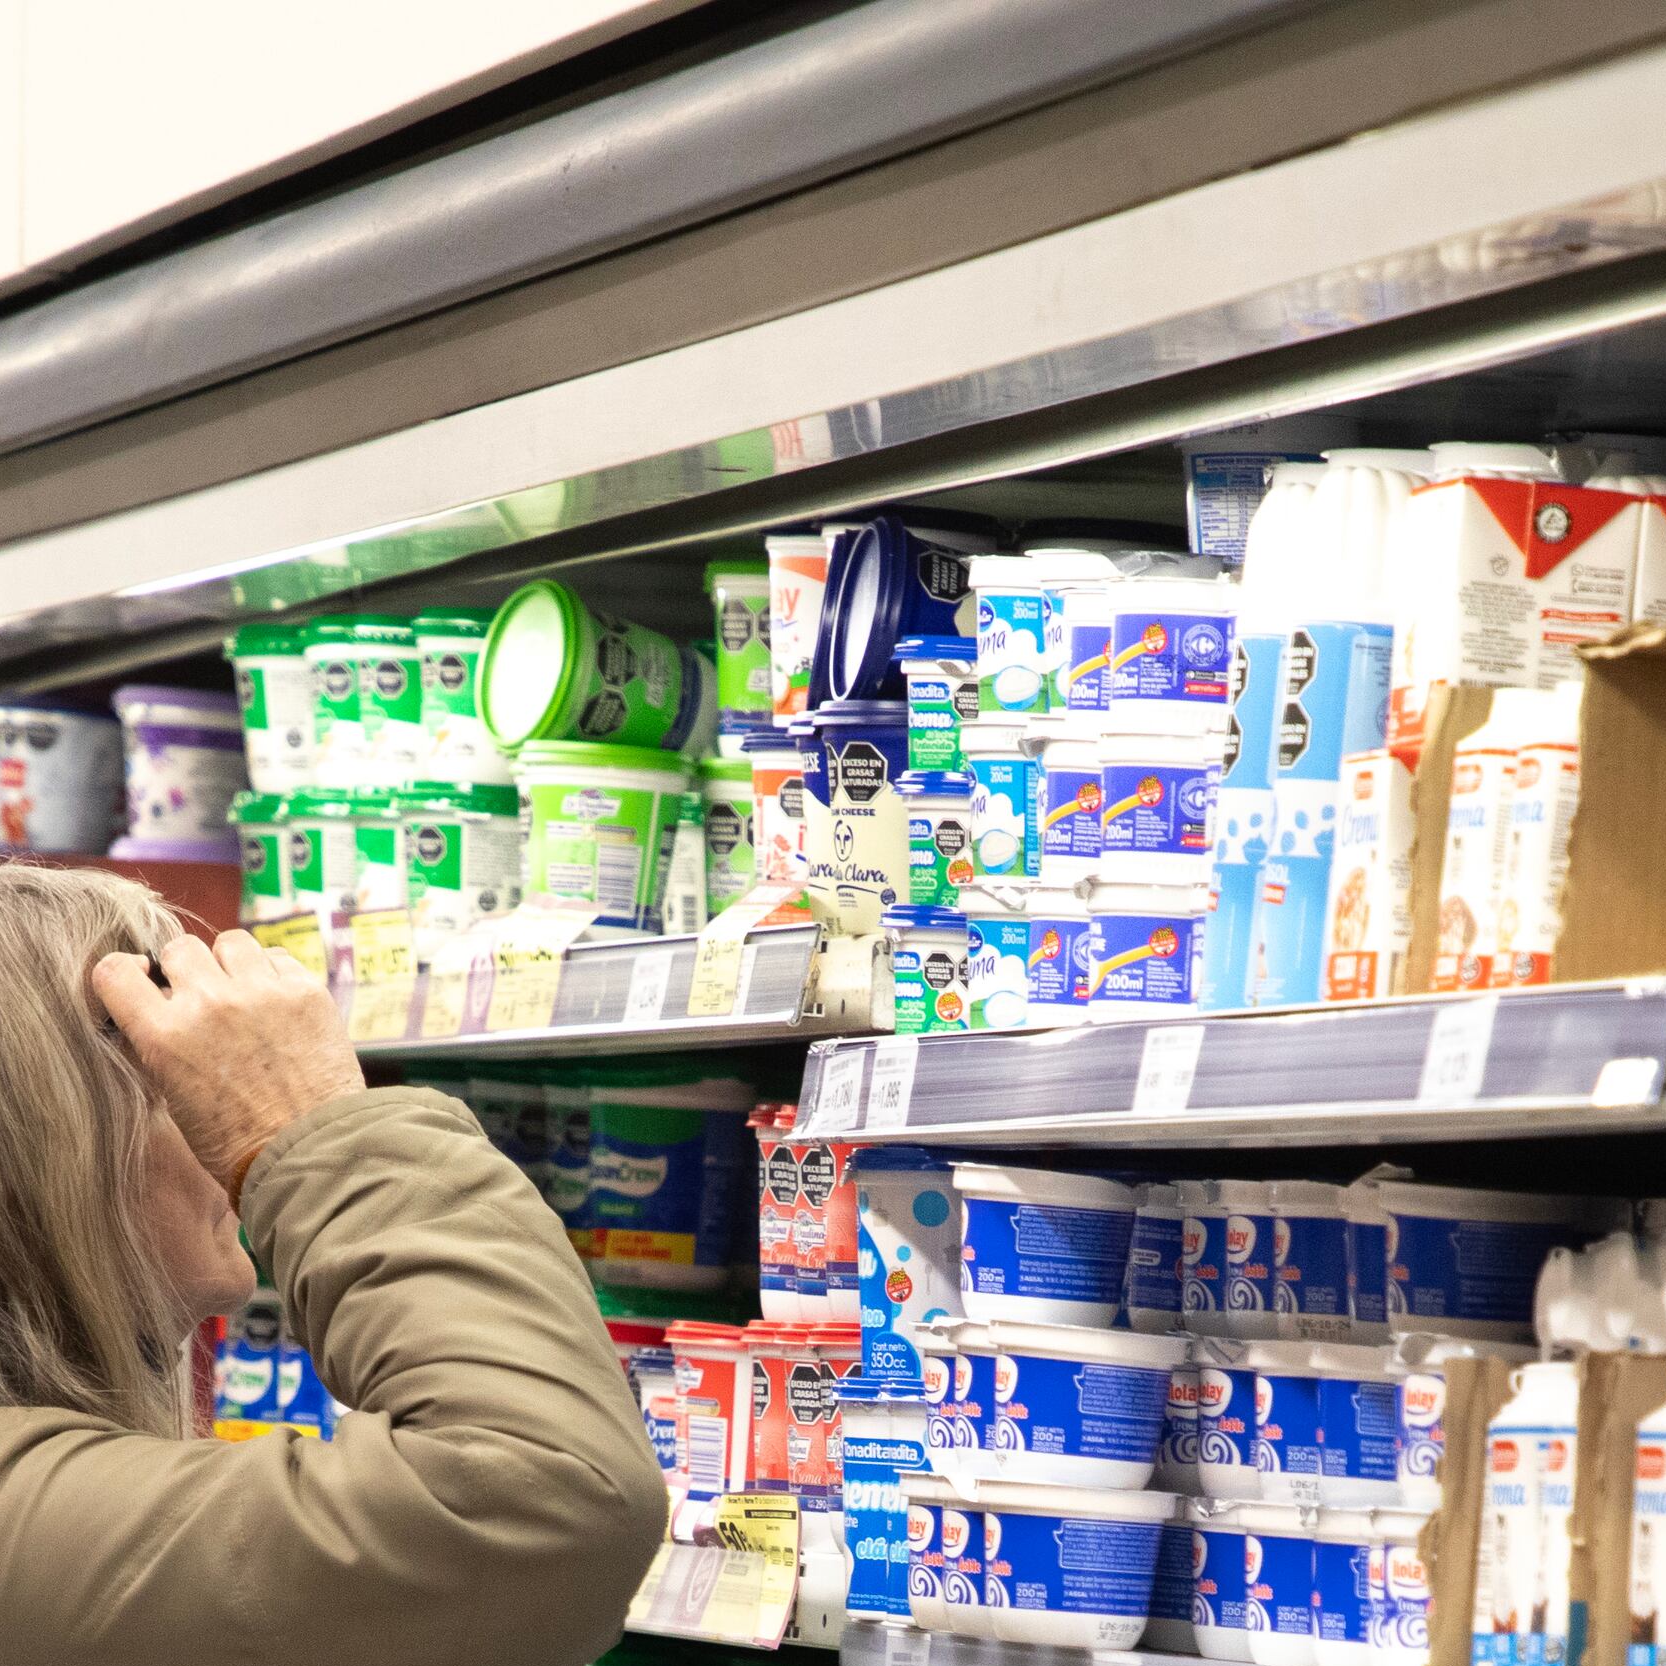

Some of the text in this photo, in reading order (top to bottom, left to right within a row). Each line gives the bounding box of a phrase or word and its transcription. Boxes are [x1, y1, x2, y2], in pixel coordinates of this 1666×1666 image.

[1105, 974, 1144, 991] 200ml
[870, 1352, 907, 1370] 350cc
[1033, 1432, 1053, 1443] 200
[1016, 1588, 1036, 1599] 200
